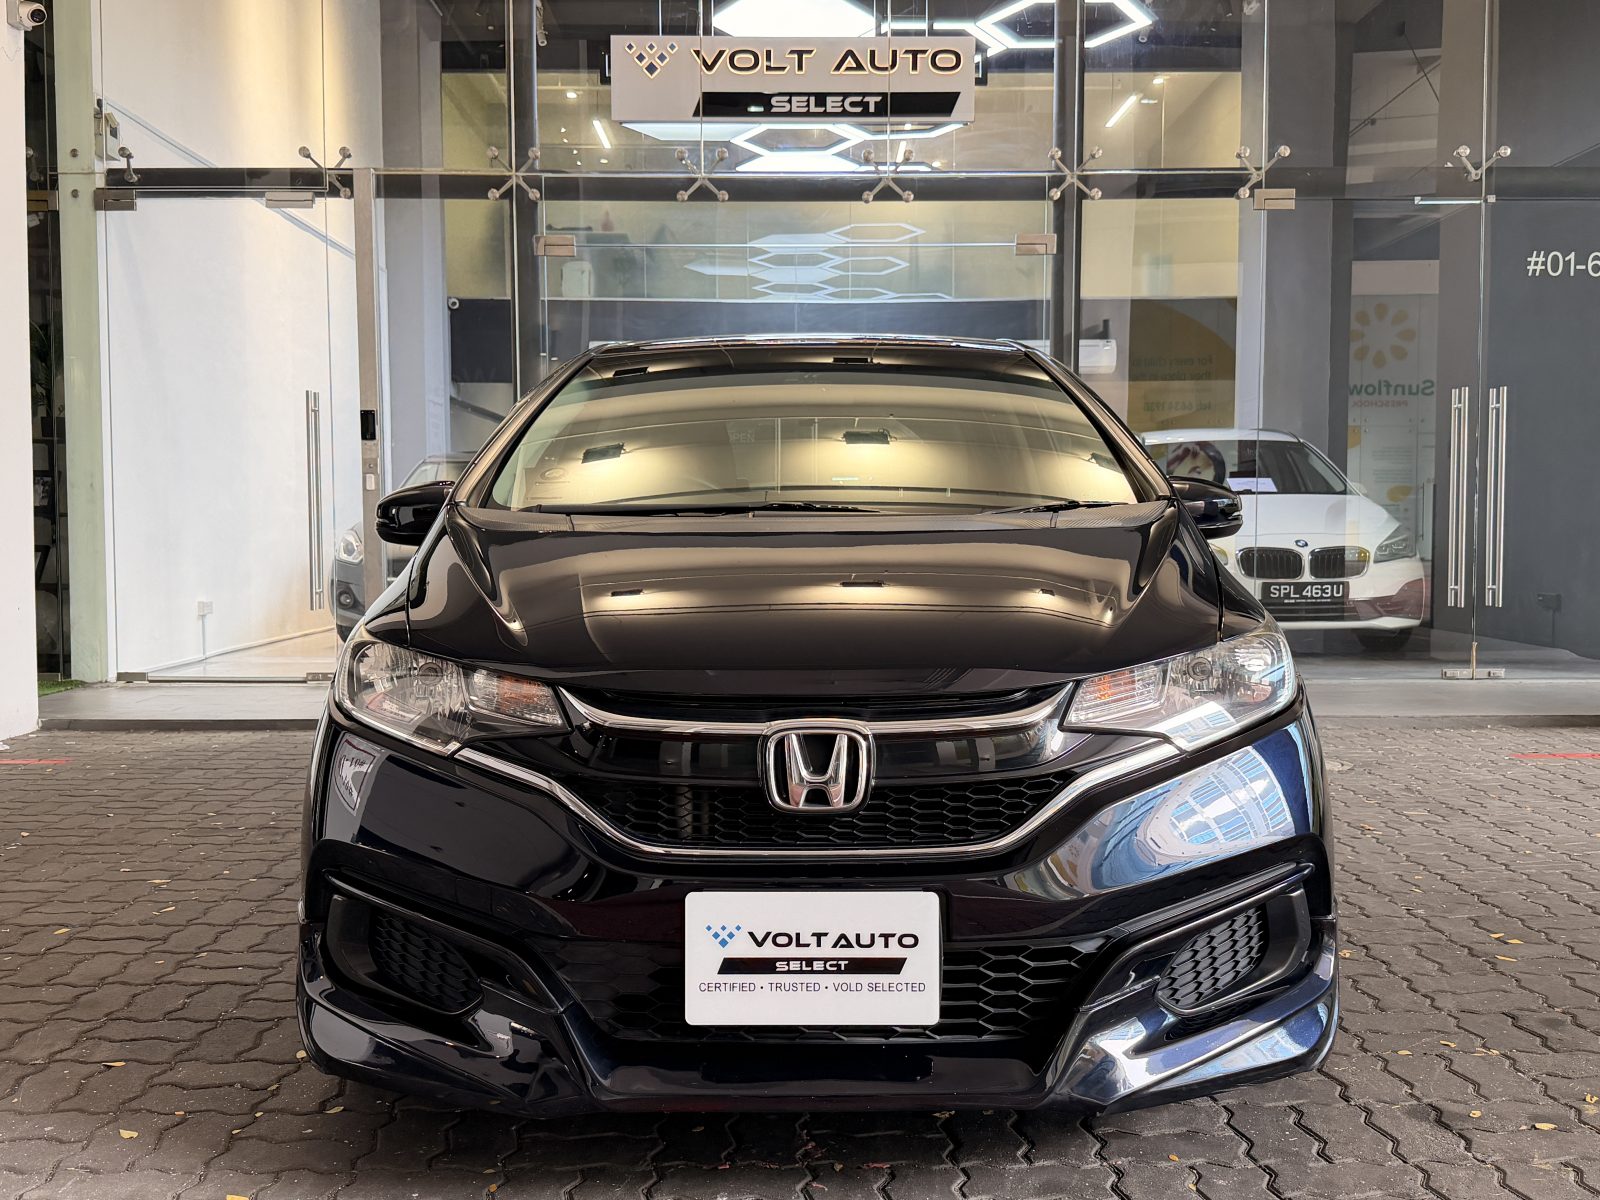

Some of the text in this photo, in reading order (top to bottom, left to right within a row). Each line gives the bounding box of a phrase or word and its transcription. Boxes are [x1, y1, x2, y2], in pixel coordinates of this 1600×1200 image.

[691, 48, 963, 74] VOLT AUTO
[770, 96, 882, 113] SELECT
[775, 960, 849, 972] SELECT
[698, 982, 926, 993] CERTIFIED TRUSTED VOLD SELECTED
